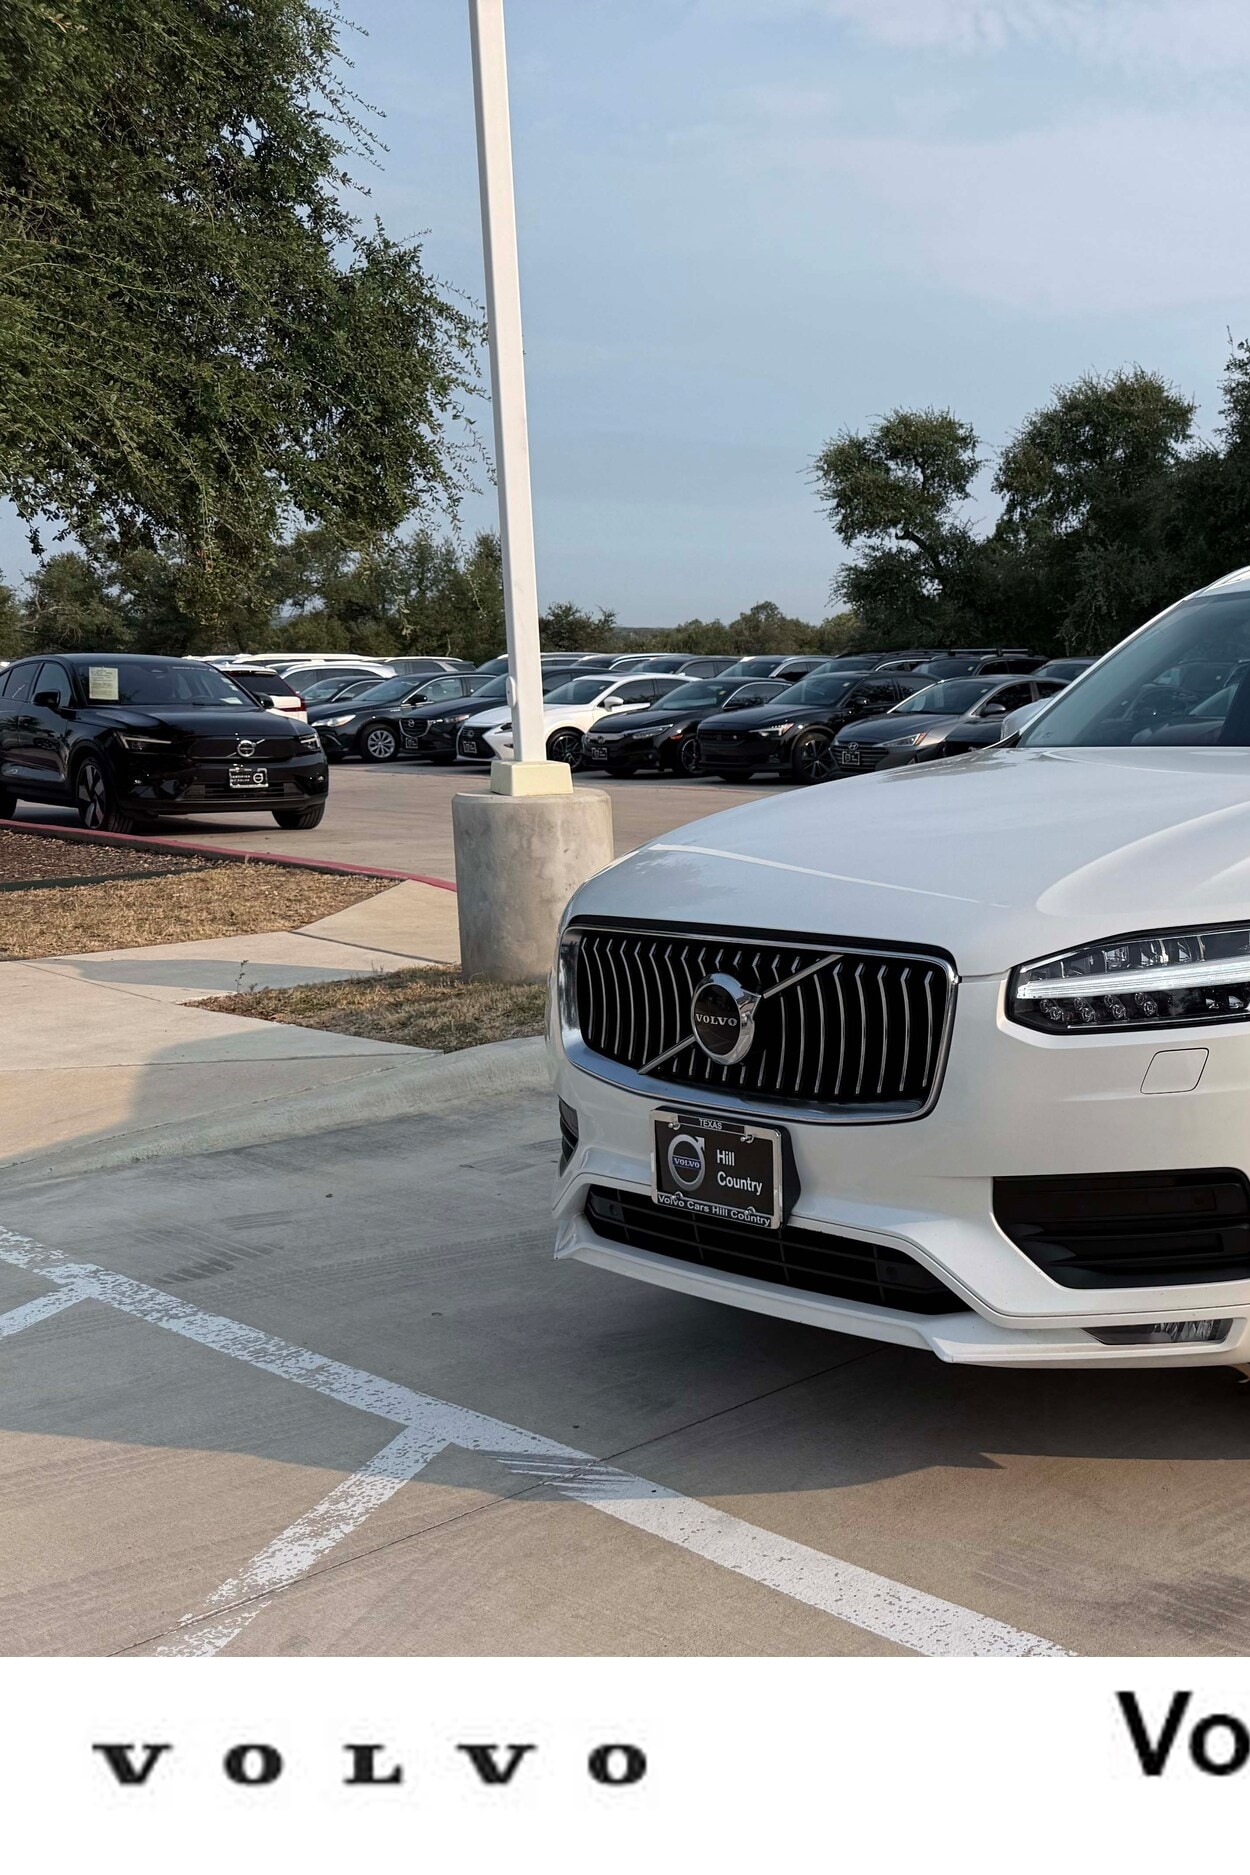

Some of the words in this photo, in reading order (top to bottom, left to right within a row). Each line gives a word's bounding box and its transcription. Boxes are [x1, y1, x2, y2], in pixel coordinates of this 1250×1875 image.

[695, 1013, 738, 1027] VOLVO
[699, 1118, 723, 1130] TEXAS
[673, 1157, 701, 1169] VOLVO
[716, 1149, 735, 1167] Hill
[717, 1171, 763, 1196] Country
[658, 1194, 685, 1208] Volvo
[686, 1200, 710, 1213] Cars
[712, 1206, 728, 1217] Hill
[730, 1210, 771, 1227] Country
